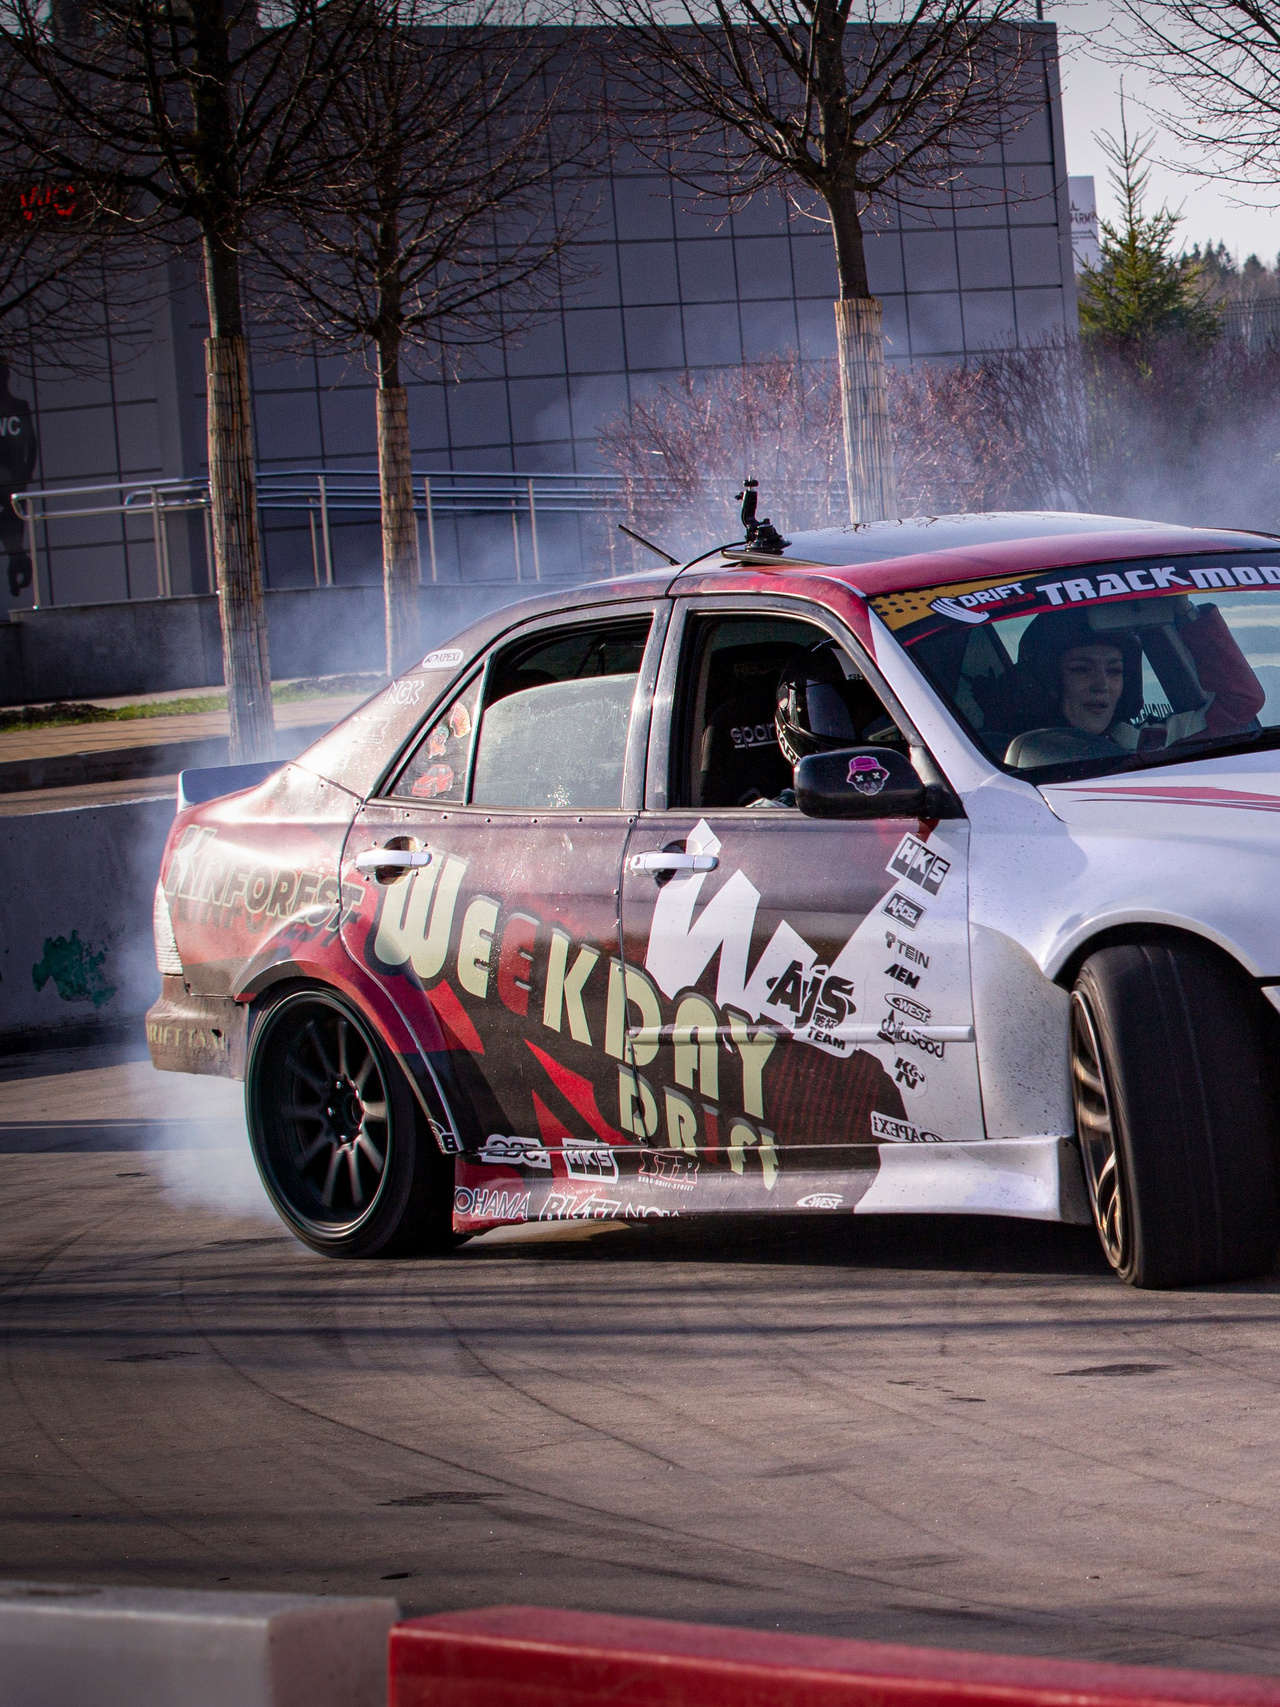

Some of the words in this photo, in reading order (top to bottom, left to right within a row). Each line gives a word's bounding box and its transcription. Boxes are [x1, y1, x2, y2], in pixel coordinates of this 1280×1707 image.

[957, 582, 1026, 608] DRIFT
[1036, 566, 1192, 606] TRACK
[896, 838, 951, 887] HKS
[896, 938, 931, 970] TEIN
[374, 851, 778, 1120] WEEKDAY
[884, 963, 921, 989] AEM
[807, 1026, 846, 1051] TEAM
[454, 1186, 532, 1221] OHAMA
